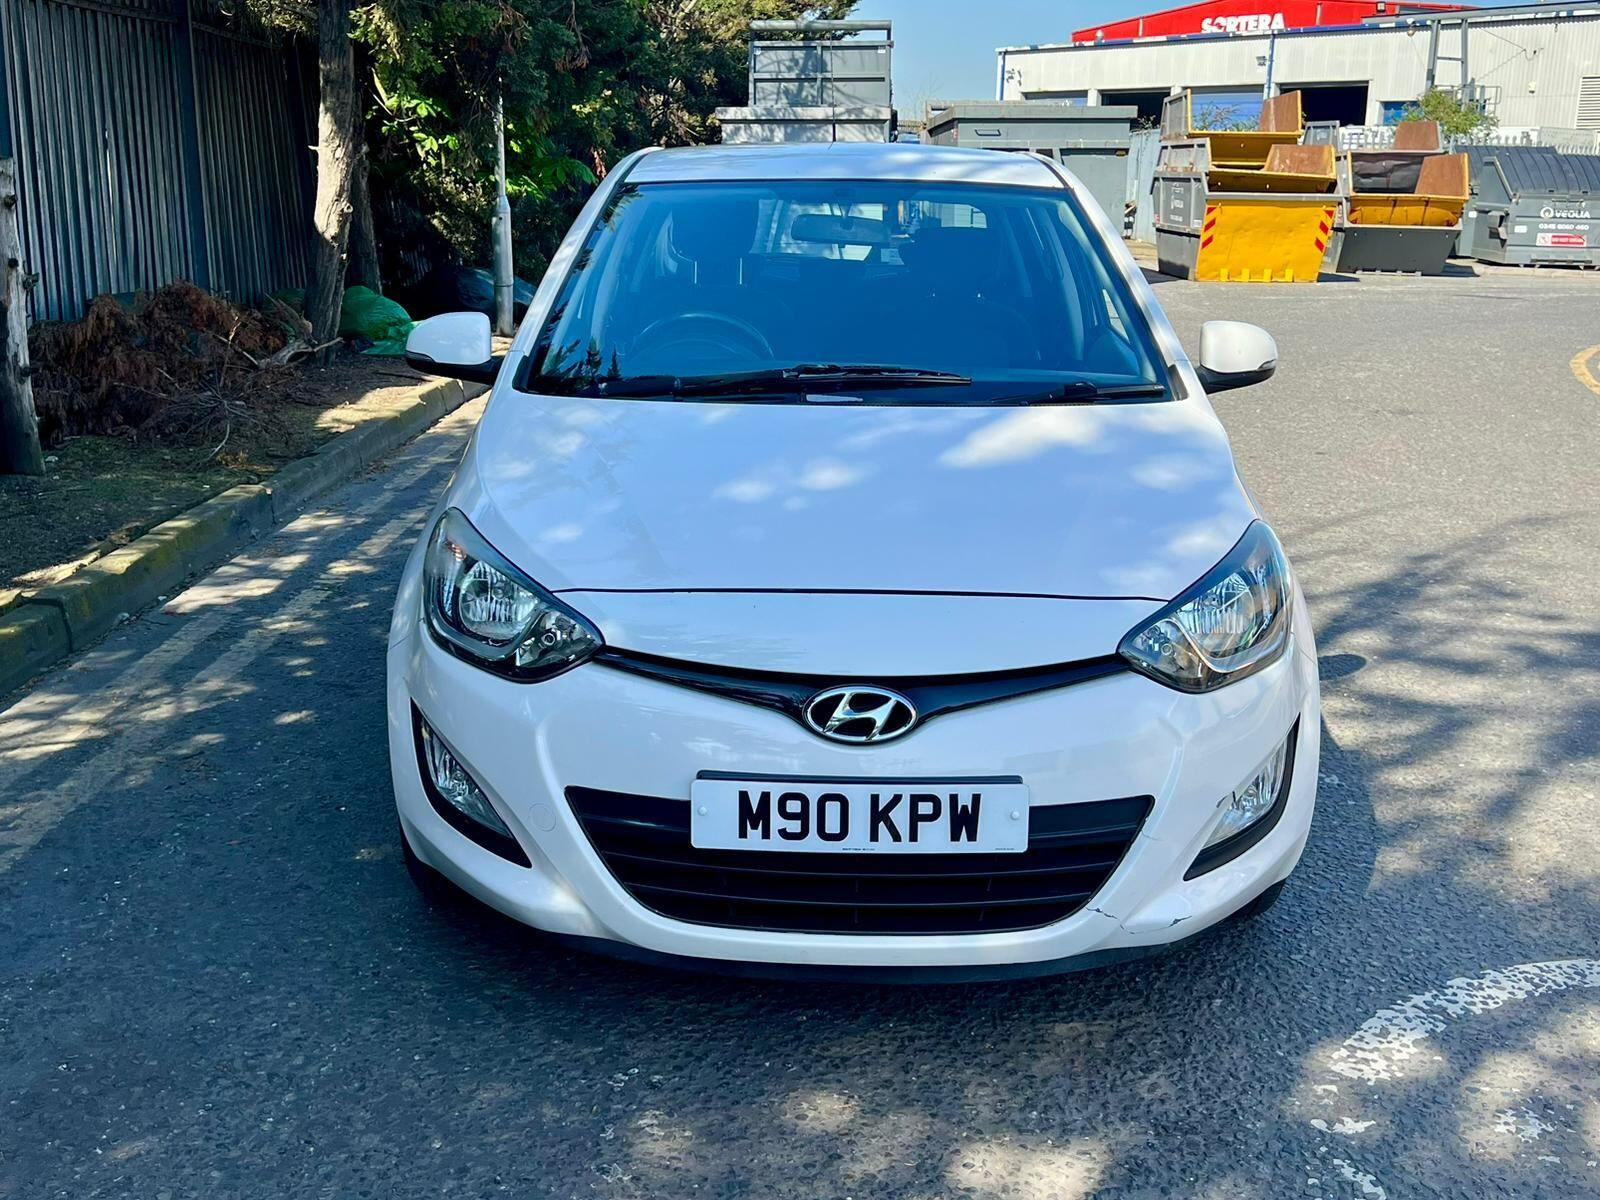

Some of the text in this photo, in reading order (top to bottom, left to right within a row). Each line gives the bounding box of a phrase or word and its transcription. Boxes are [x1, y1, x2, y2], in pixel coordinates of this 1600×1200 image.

[1201, 13, 1285, 33] SORTERA
[738, 790, 982, 843] M90 KPW
